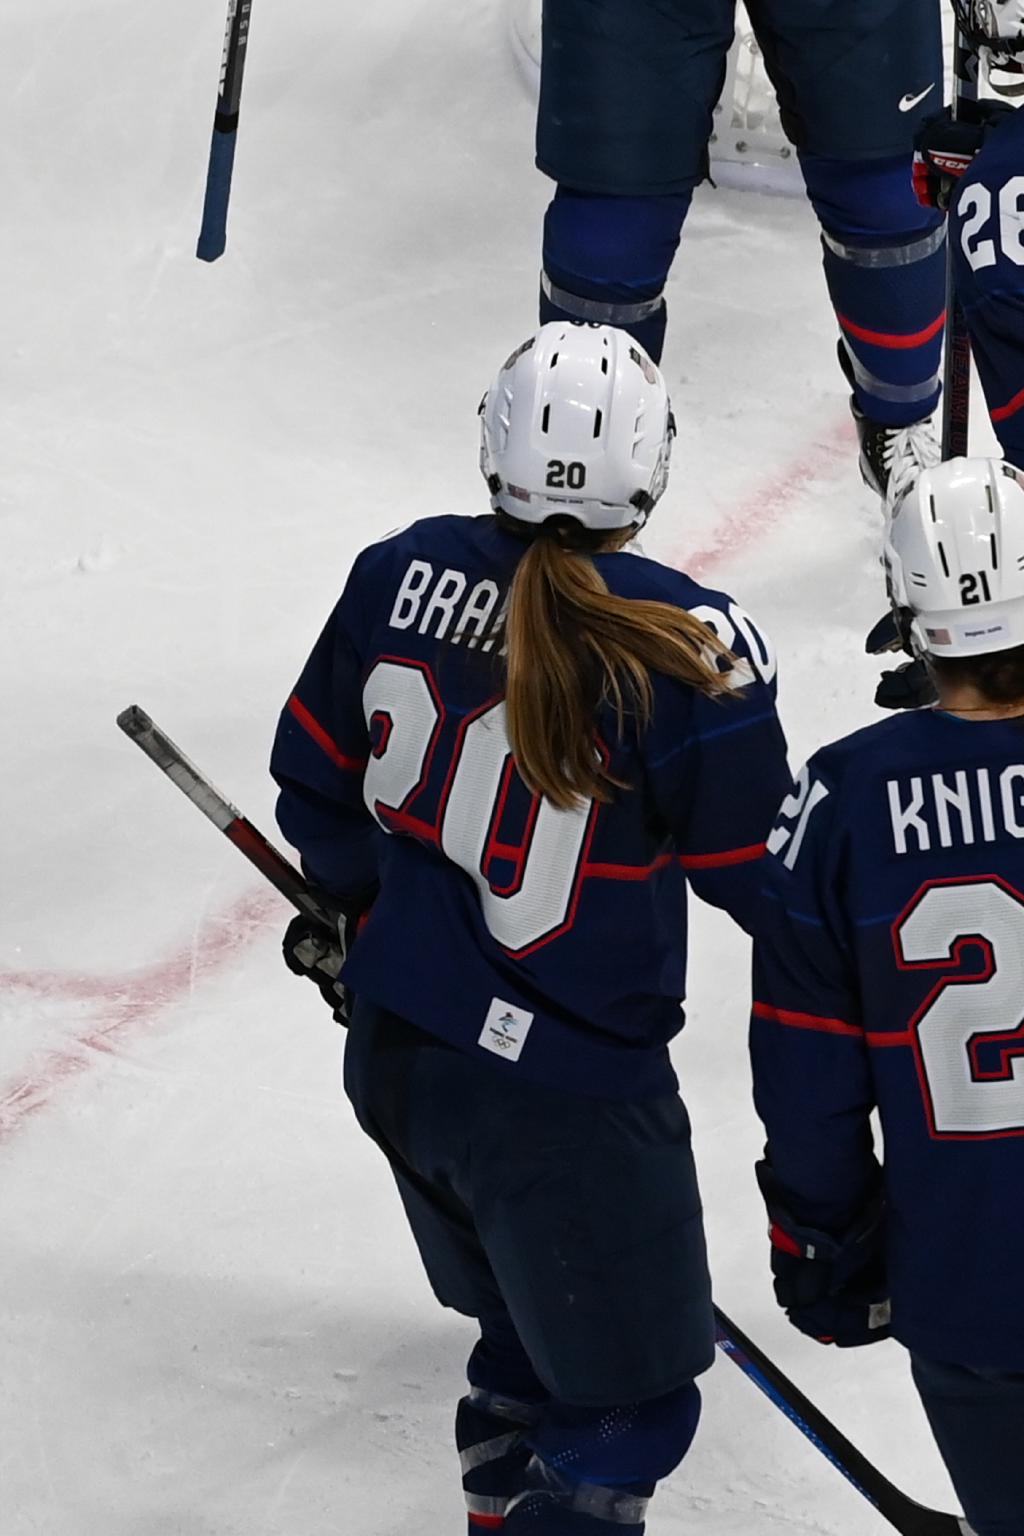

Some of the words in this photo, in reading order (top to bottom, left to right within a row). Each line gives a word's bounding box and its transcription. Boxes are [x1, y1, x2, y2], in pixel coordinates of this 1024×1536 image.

[933, 157, 969, 169] CCM
[545, 459, 586, 490] 20
[959, 570, 992, 606] 21
[362, 654, 611, 961] 20
